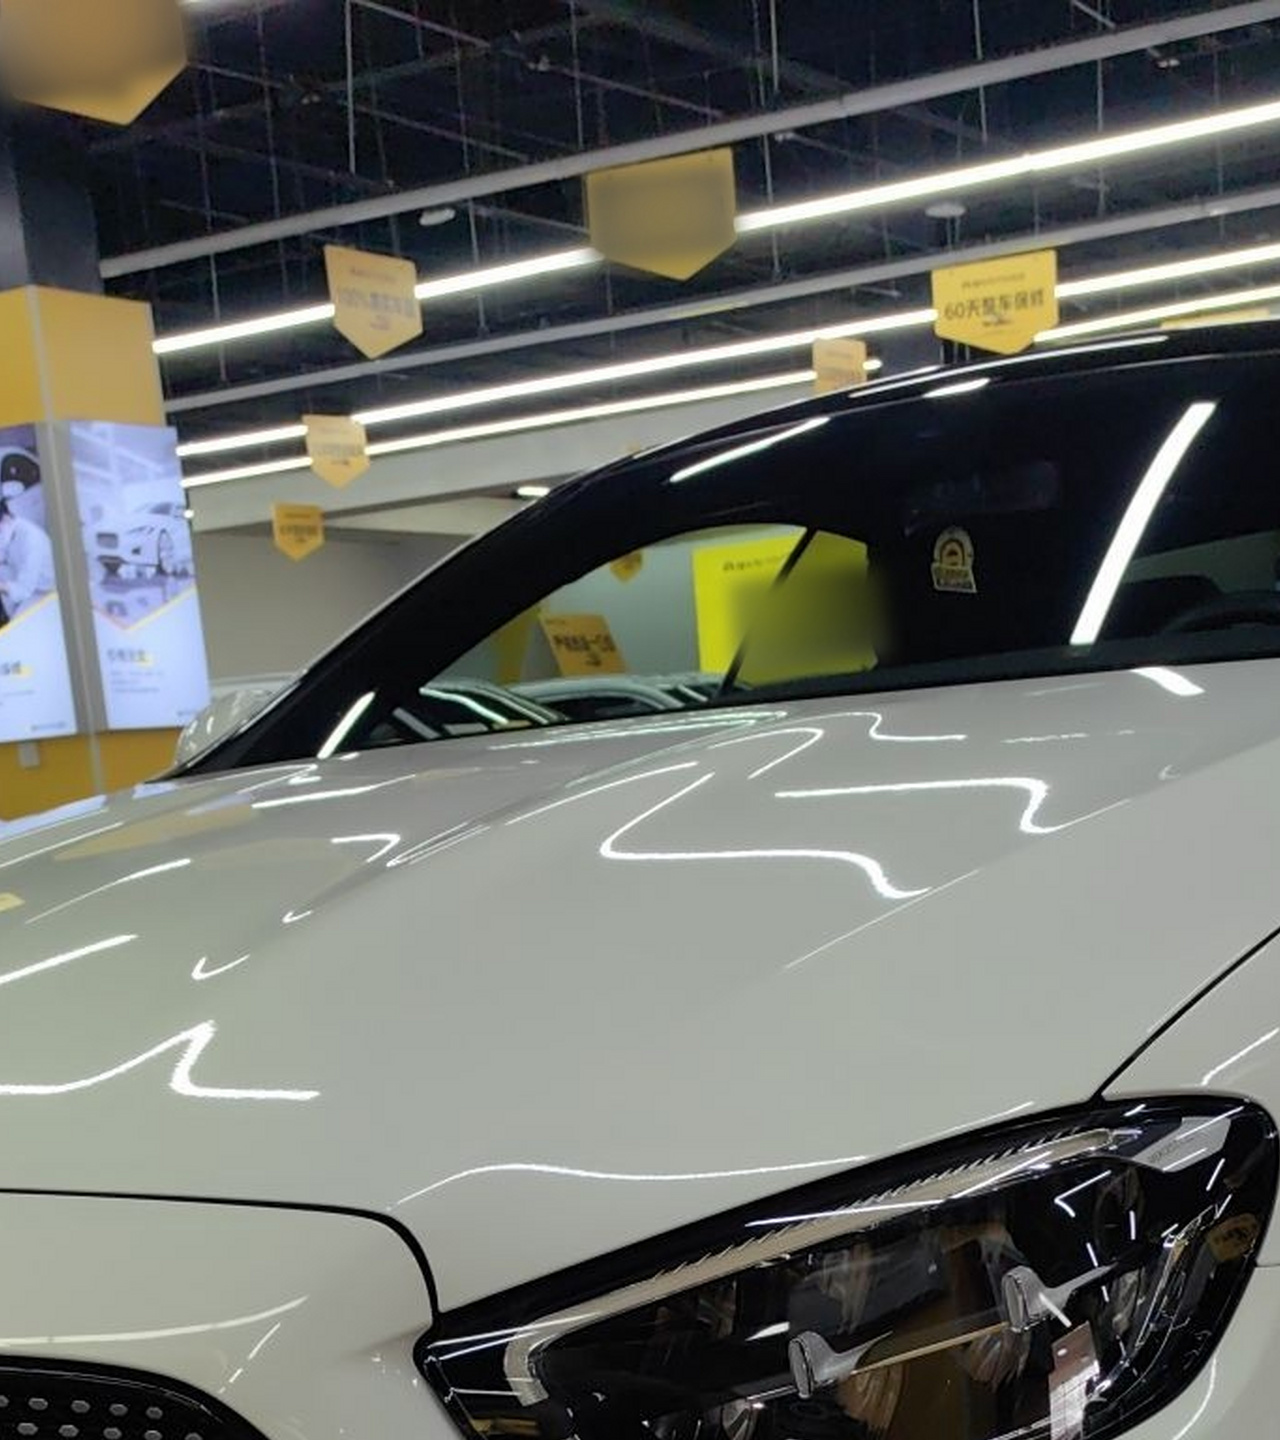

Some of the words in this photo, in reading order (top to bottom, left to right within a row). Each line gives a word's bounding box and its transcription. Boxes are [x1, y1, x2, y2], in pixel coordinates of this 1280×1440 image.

[943, 288, 1044, 321] 60天整车保修
